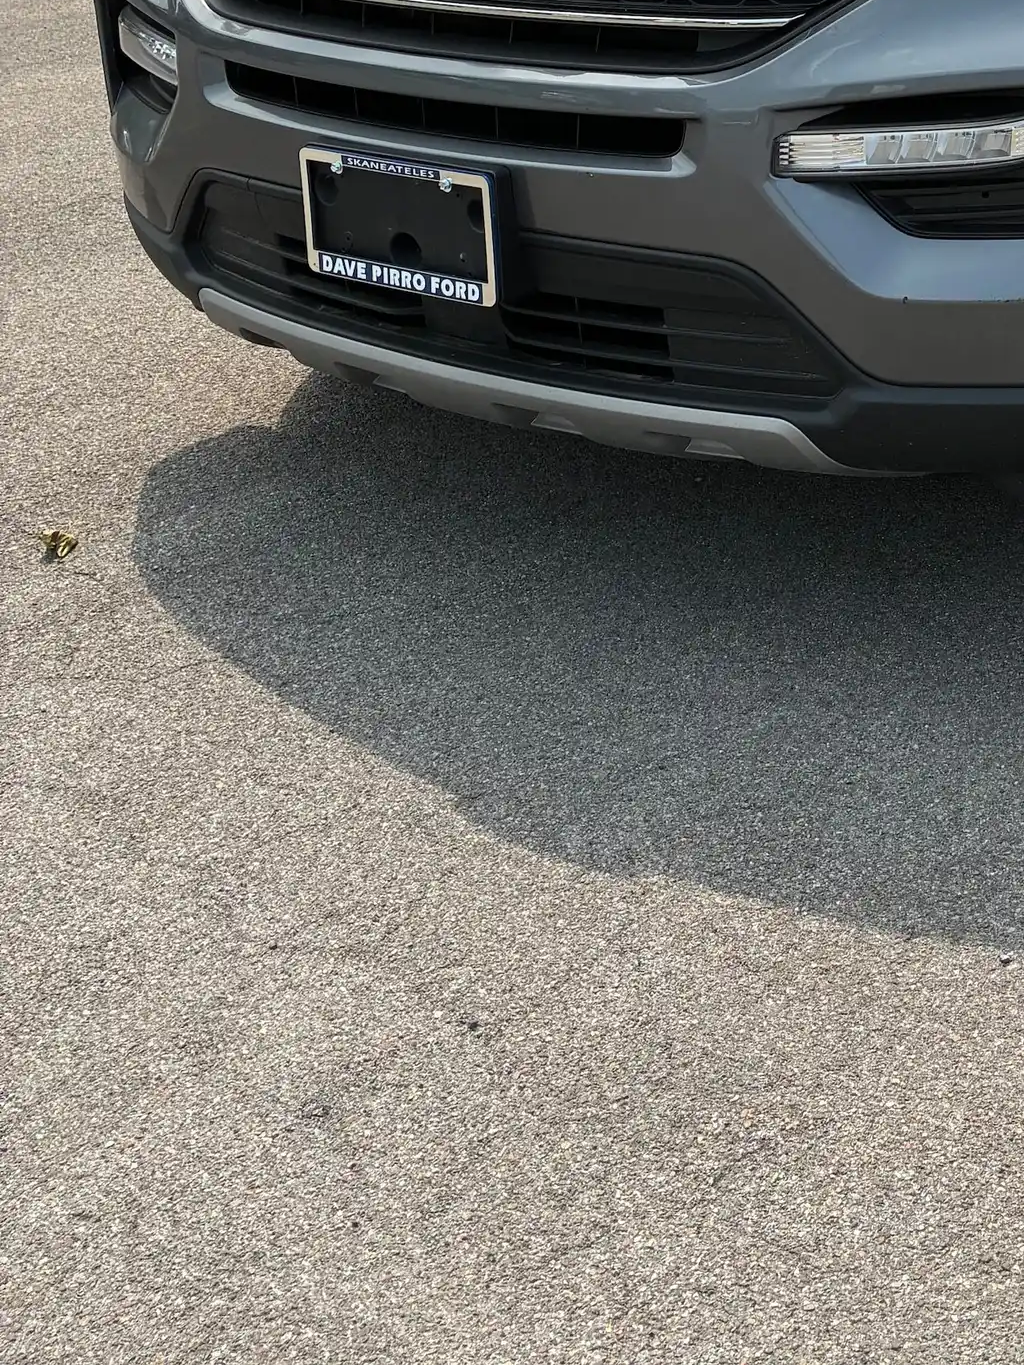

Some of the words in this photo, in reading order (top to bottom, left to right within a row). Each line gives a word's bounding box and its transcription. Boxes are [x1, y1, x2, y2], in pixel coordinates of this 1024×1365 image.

[347, 157, 435, 178] SKANEATELES
[322, 254, 367, 281] DAVE
[371, 265, 426, 291] PIRRO
[430, 278, 480, 302] FORD
